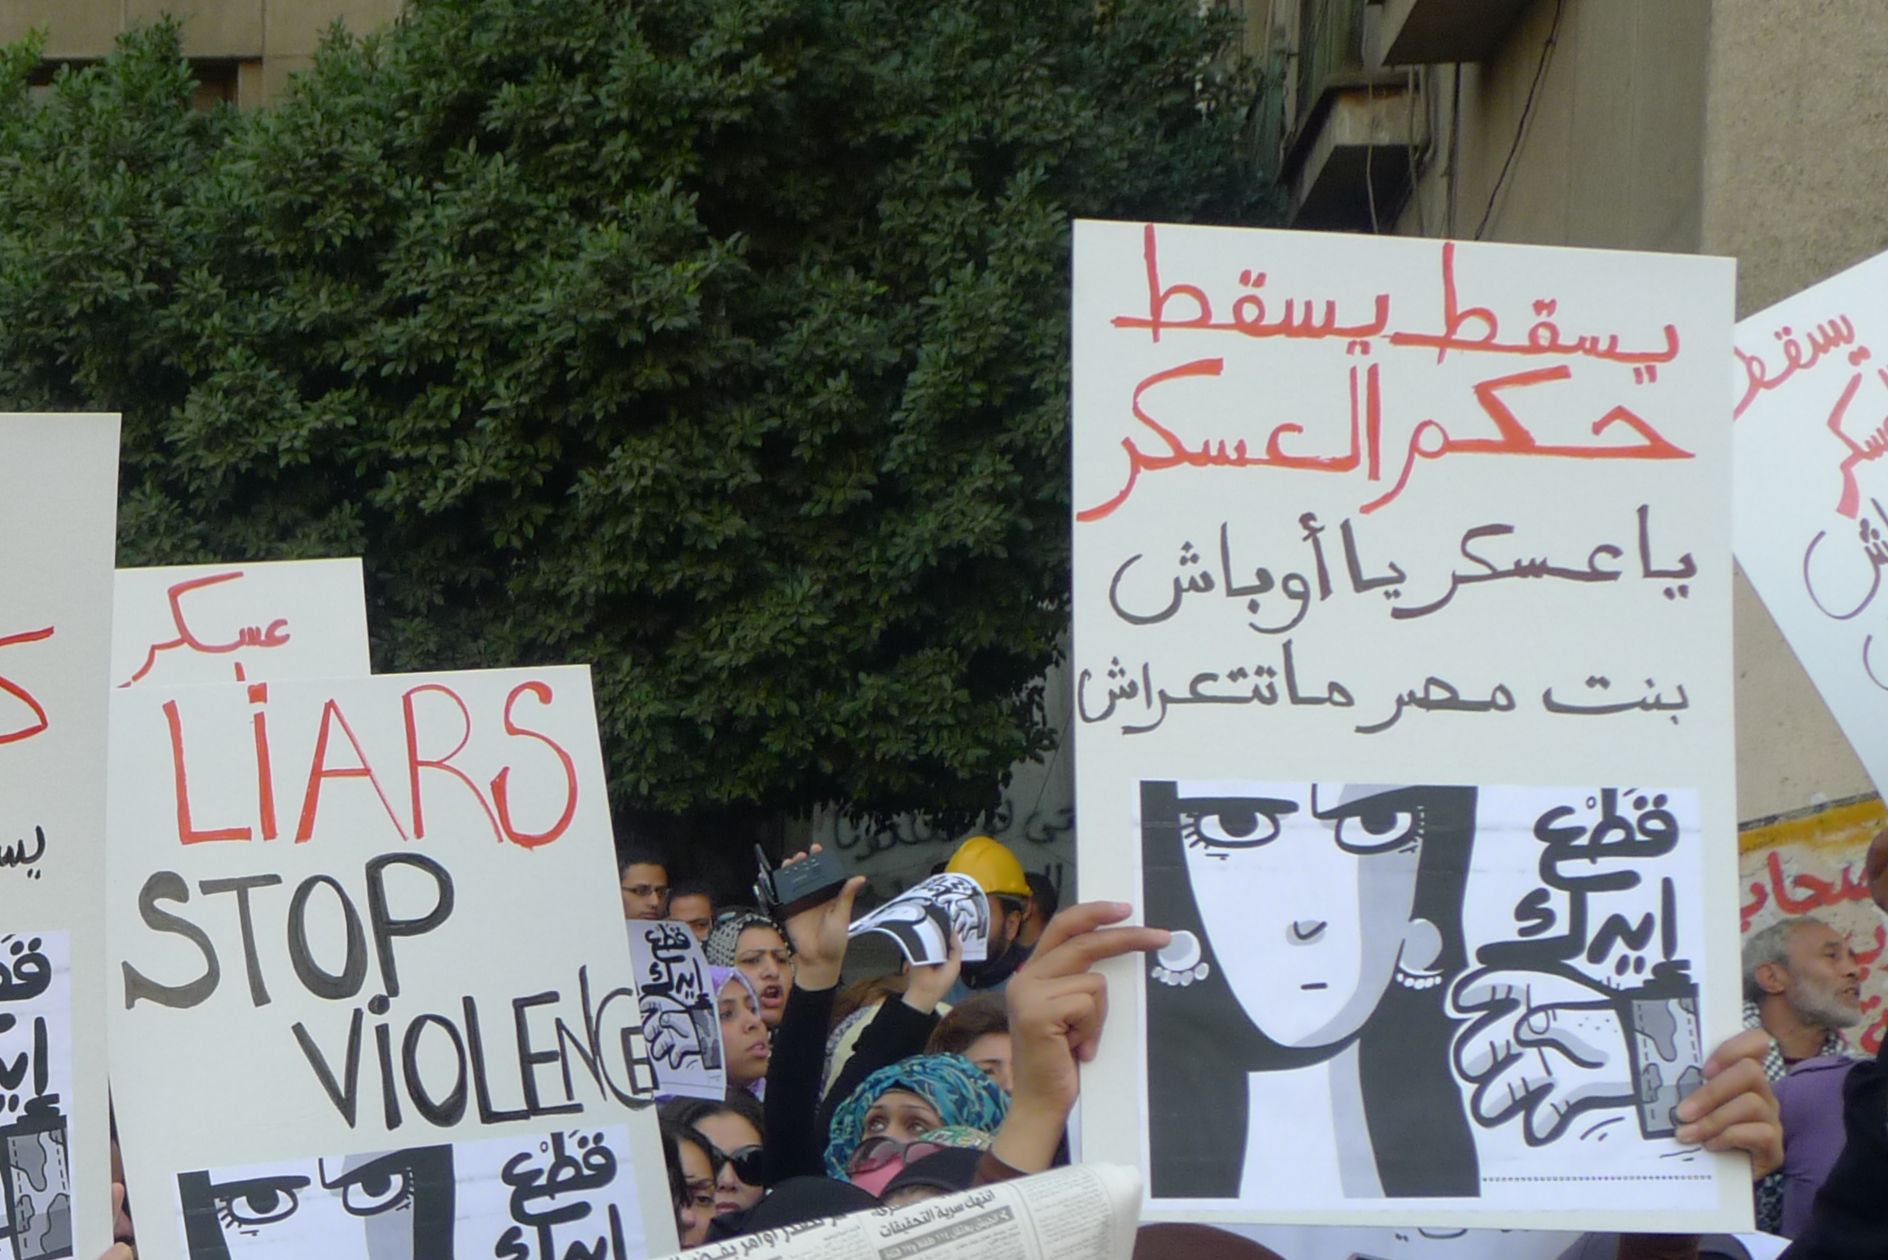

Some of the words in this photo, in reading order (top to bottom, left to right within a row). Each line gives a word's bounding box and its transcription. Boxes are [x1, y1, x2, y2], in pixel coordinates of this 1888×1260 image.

[1111, 222, 1390, 356] يسقط
[1387, 240, 1678, 385] يسقط
[1076, 357, 1381, 522] العسكر
[1360, 364, 1696, 515] حكم
[117, 571, 291, 689] عسكر
[1354, 676, 1516, 734] مصر
[1542, 675, 1689, 725] بنت
[121, 852, 454, 1010] STOP
